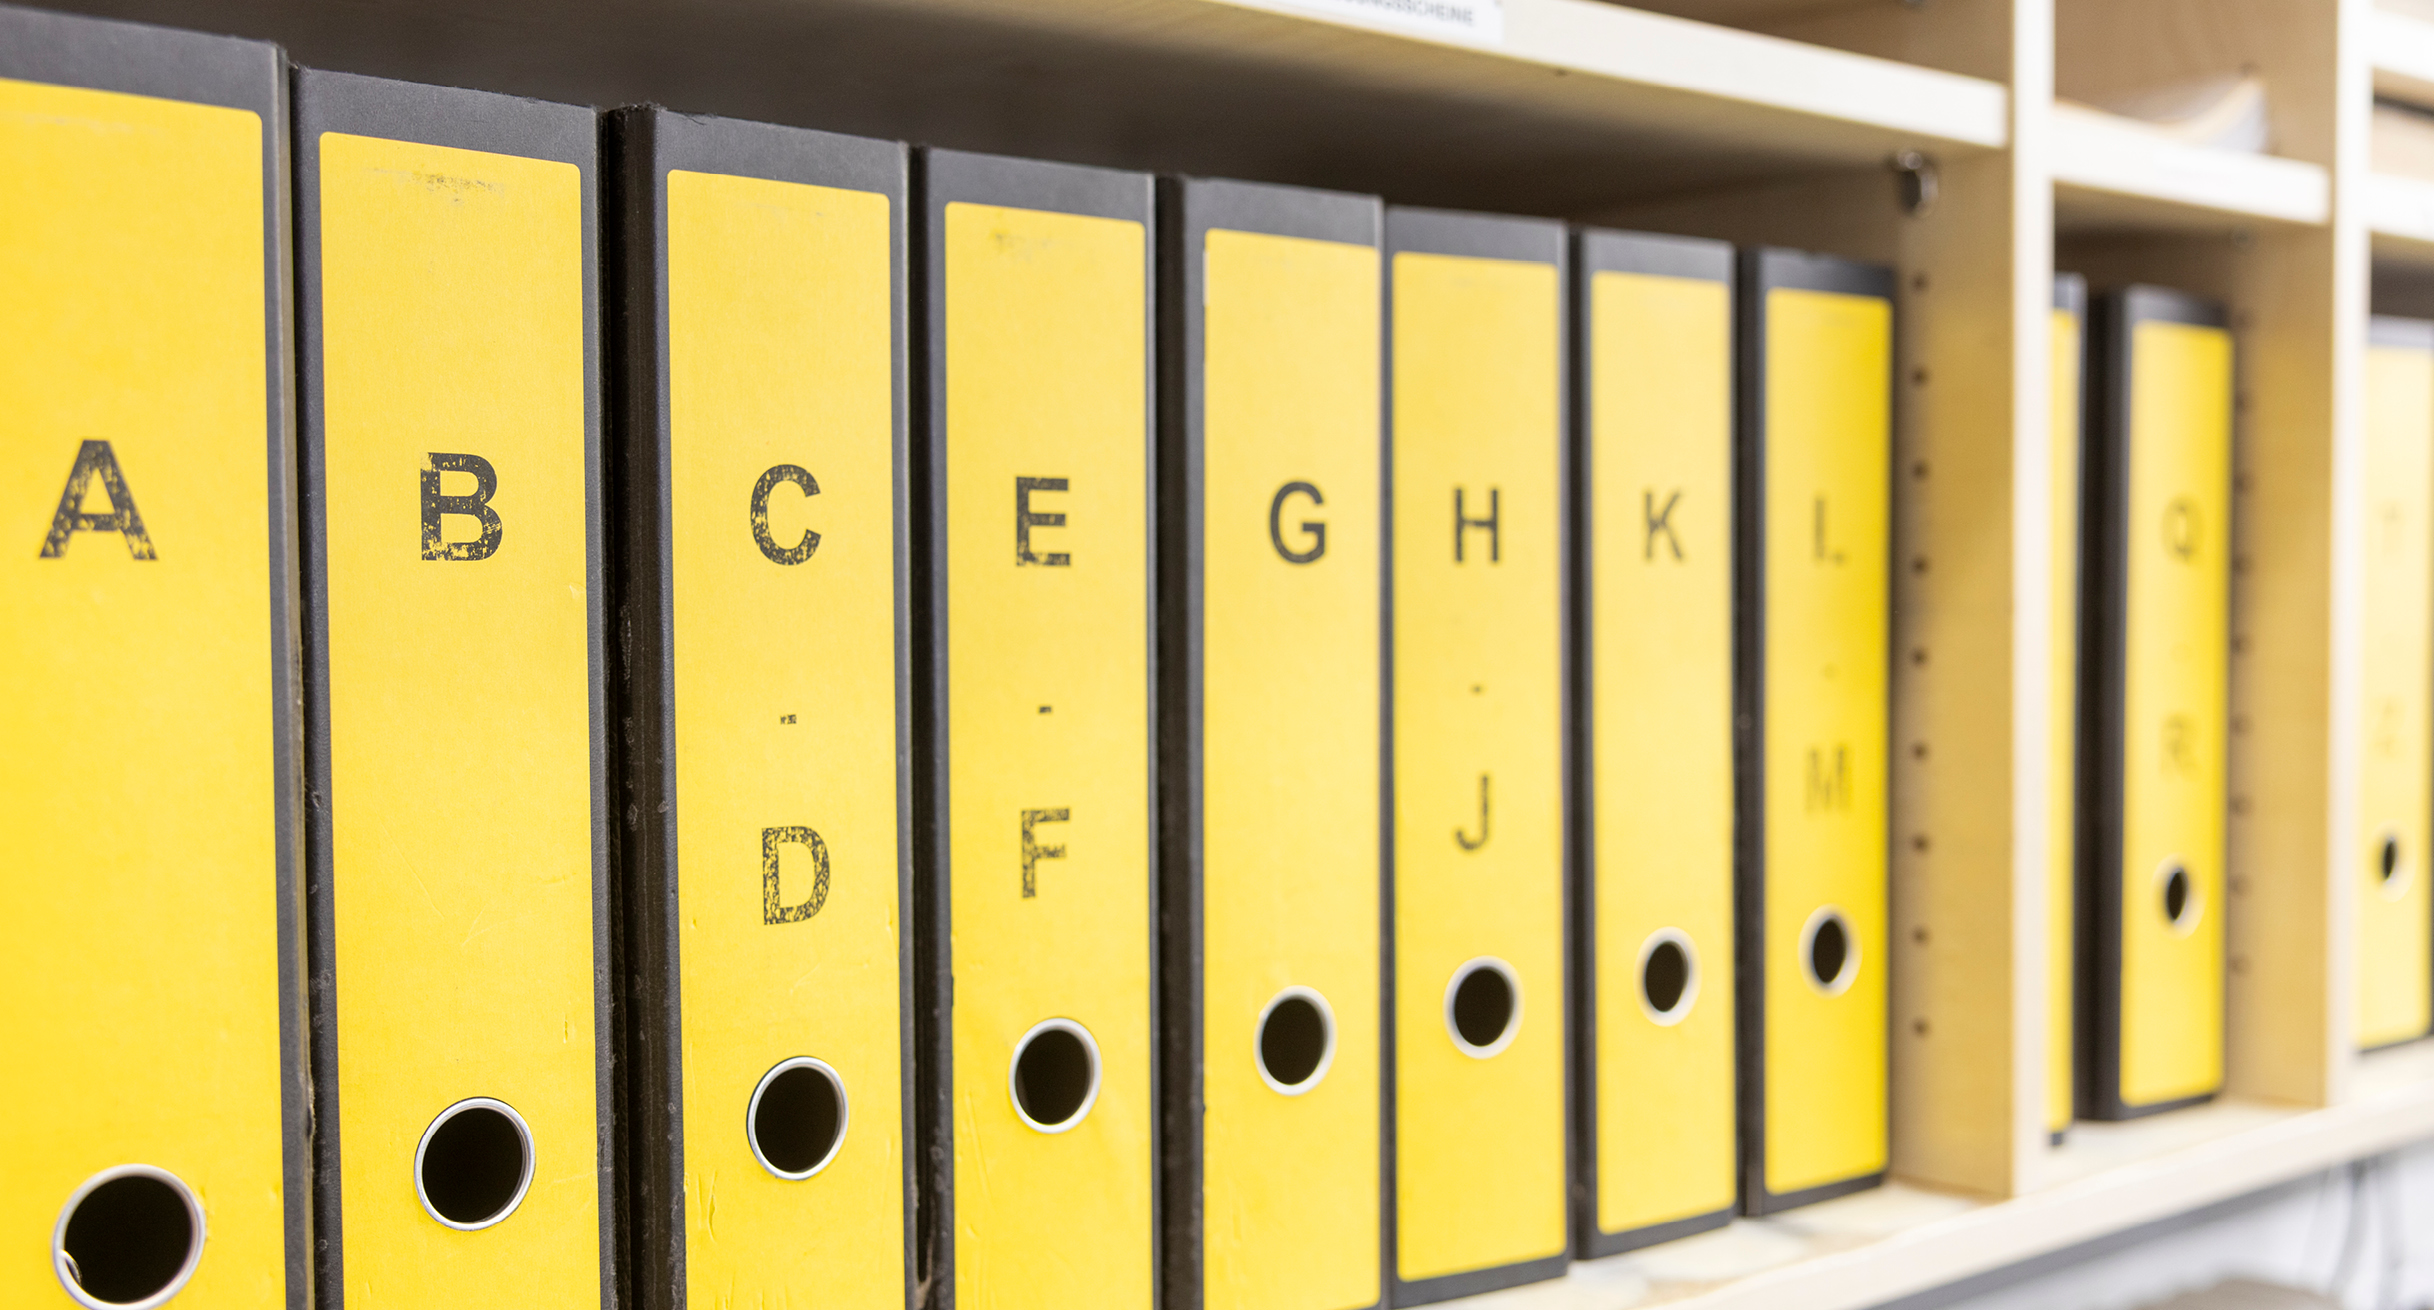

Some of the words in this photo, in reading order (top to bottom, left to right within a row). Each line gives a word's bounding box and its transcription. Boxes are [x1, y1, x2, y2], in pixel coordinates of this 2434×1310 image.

[39, 440, 158, 560] A
[420, 453, 503, 561] B
[750, 464, 822, 565] C
[1015, 476, 1071, 567] E
[1268, 481, 1327, 564] G
[1454, 488, 1500, 563] H
[1644, 492, 1684, 562] K
[1812, 496, 1847, 564] L
[1454, 775, 1490, 852] J
[1806, 744, 1851, 813] M
[762, 826, 830, 925] D
[1021, 807, 1071, 899] F
